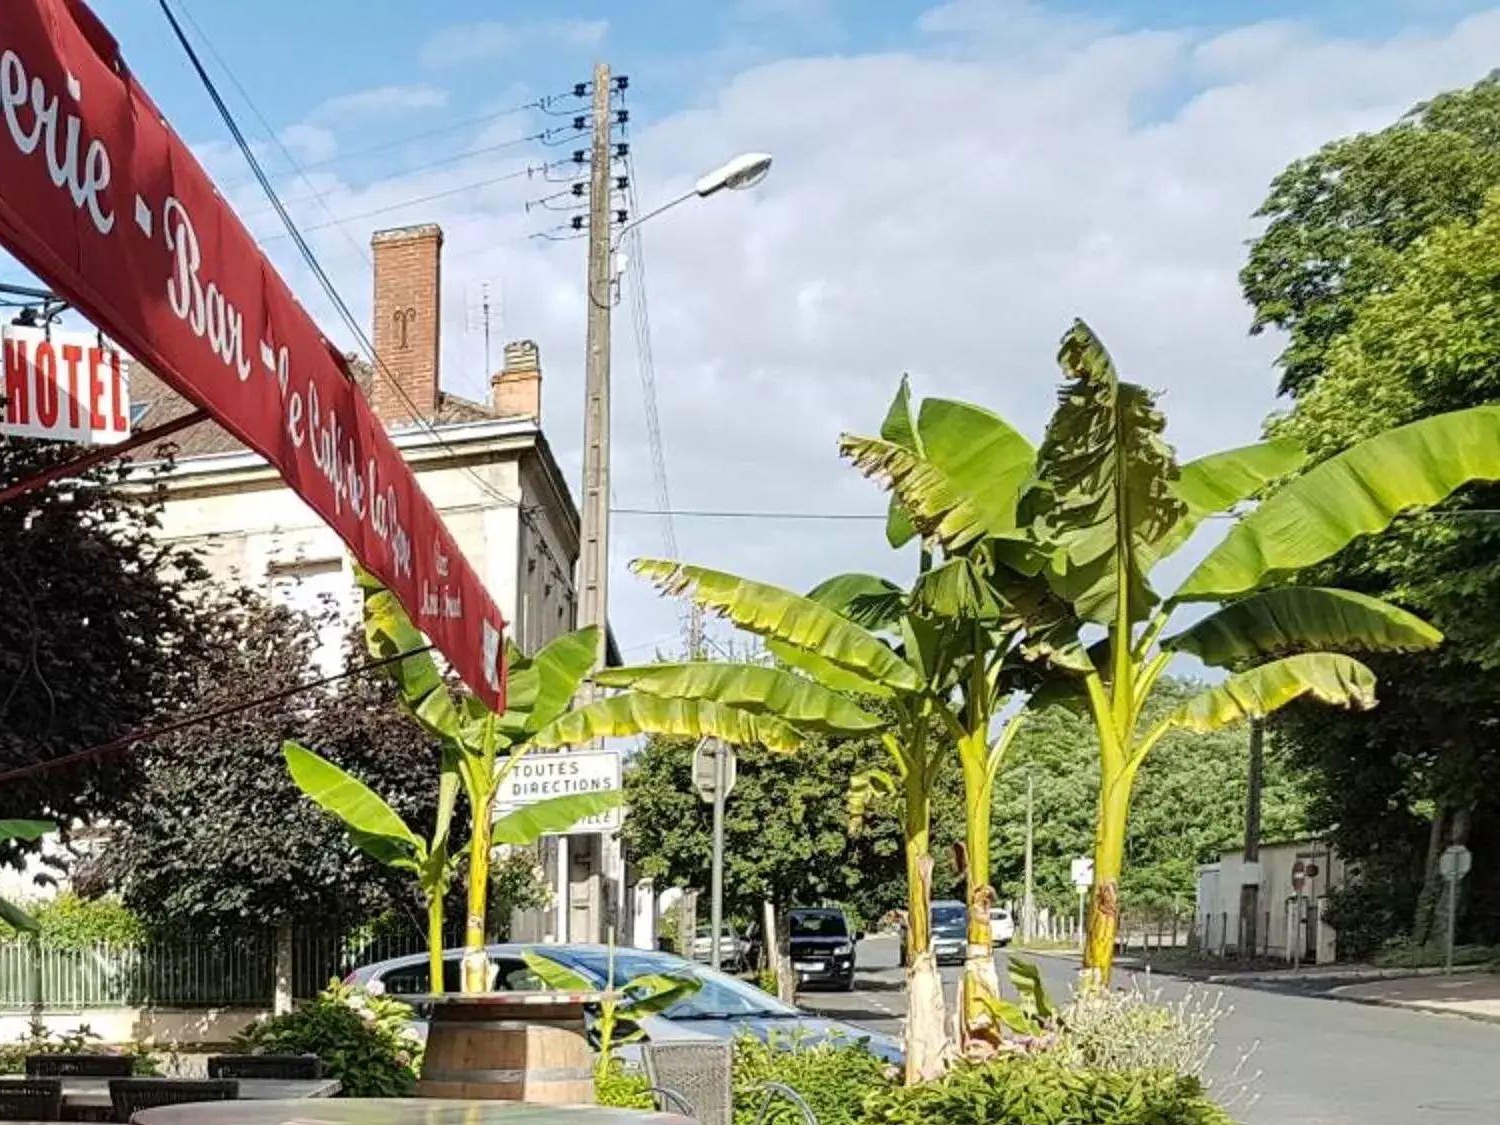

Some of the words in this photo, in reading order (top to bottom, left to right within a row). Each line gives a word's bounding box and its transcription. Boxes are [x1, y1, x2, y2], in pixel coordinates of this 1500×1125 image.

[163, 196, 251, 382] Bar
[4, 337, 127, 433] HOTEL
[511, 777, 613, 797] DIRECTIONS
[512, 761, 580, 778] TOUTES
